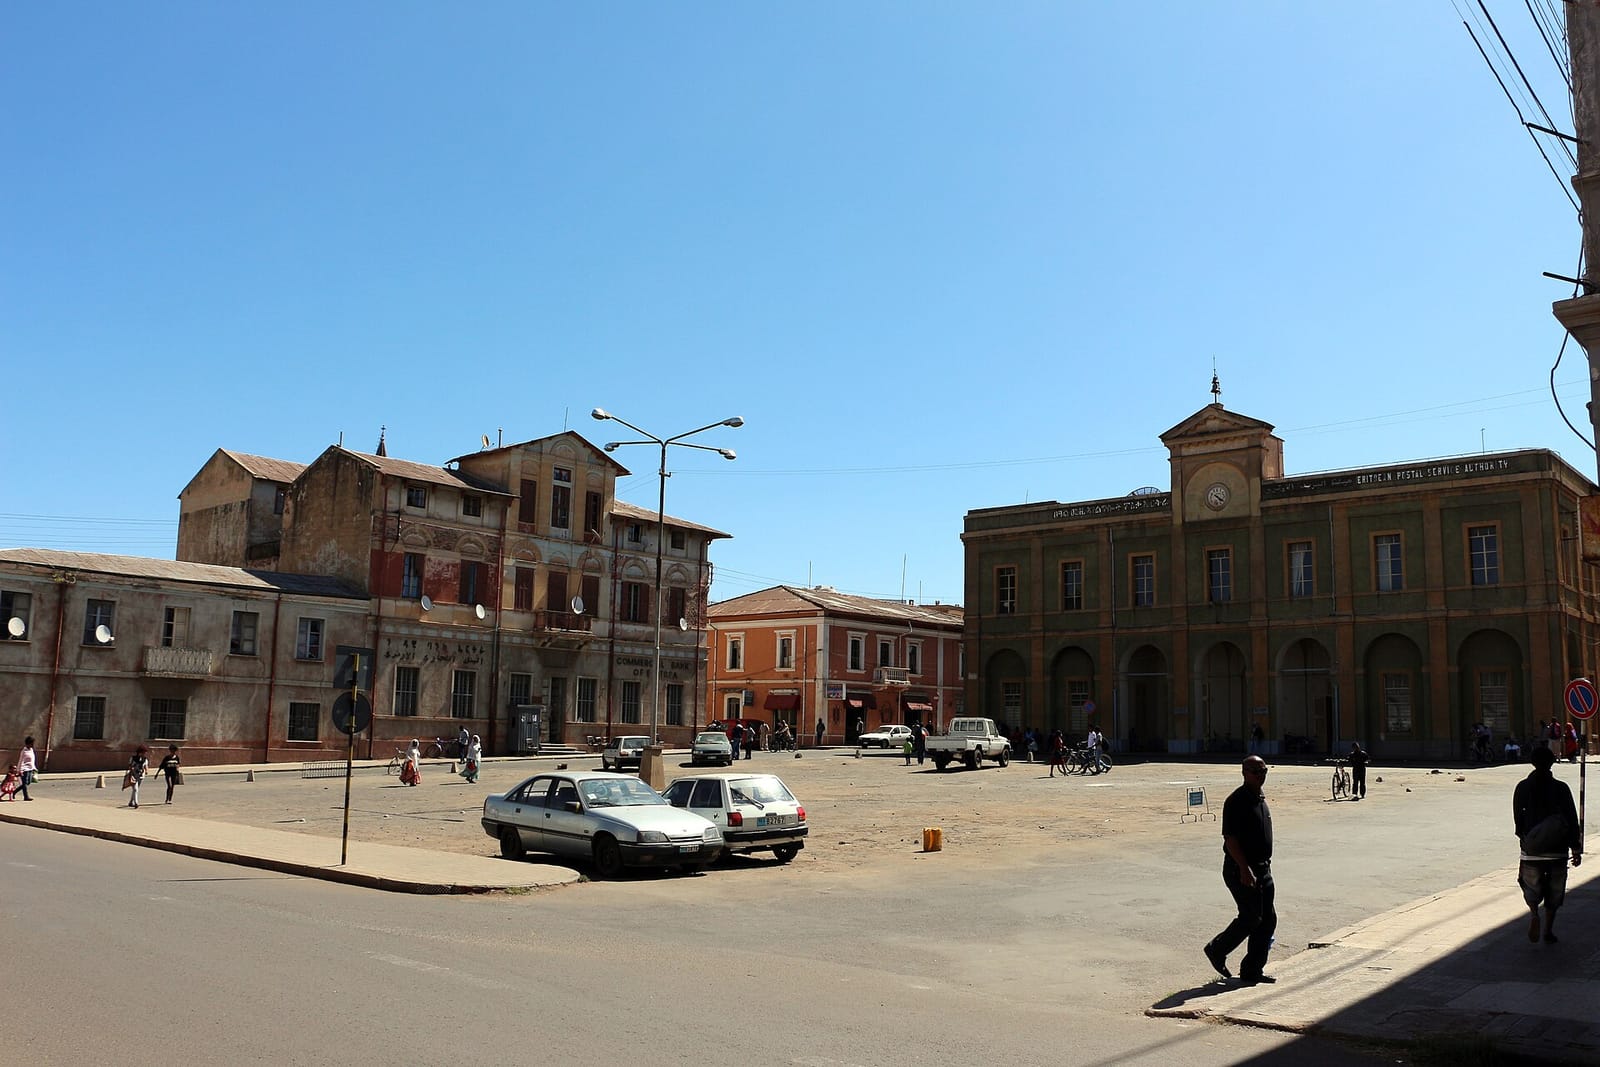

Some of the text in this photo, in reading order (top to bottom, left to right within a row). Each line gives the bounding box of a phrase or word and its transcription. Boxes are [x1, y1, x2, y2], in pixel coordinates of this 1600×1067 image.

[1396, 469, 1423, 480] POSTAL
[616, 656, 665, 669] COMMERCL
[633, 668, 678, 680] OF ETREA
